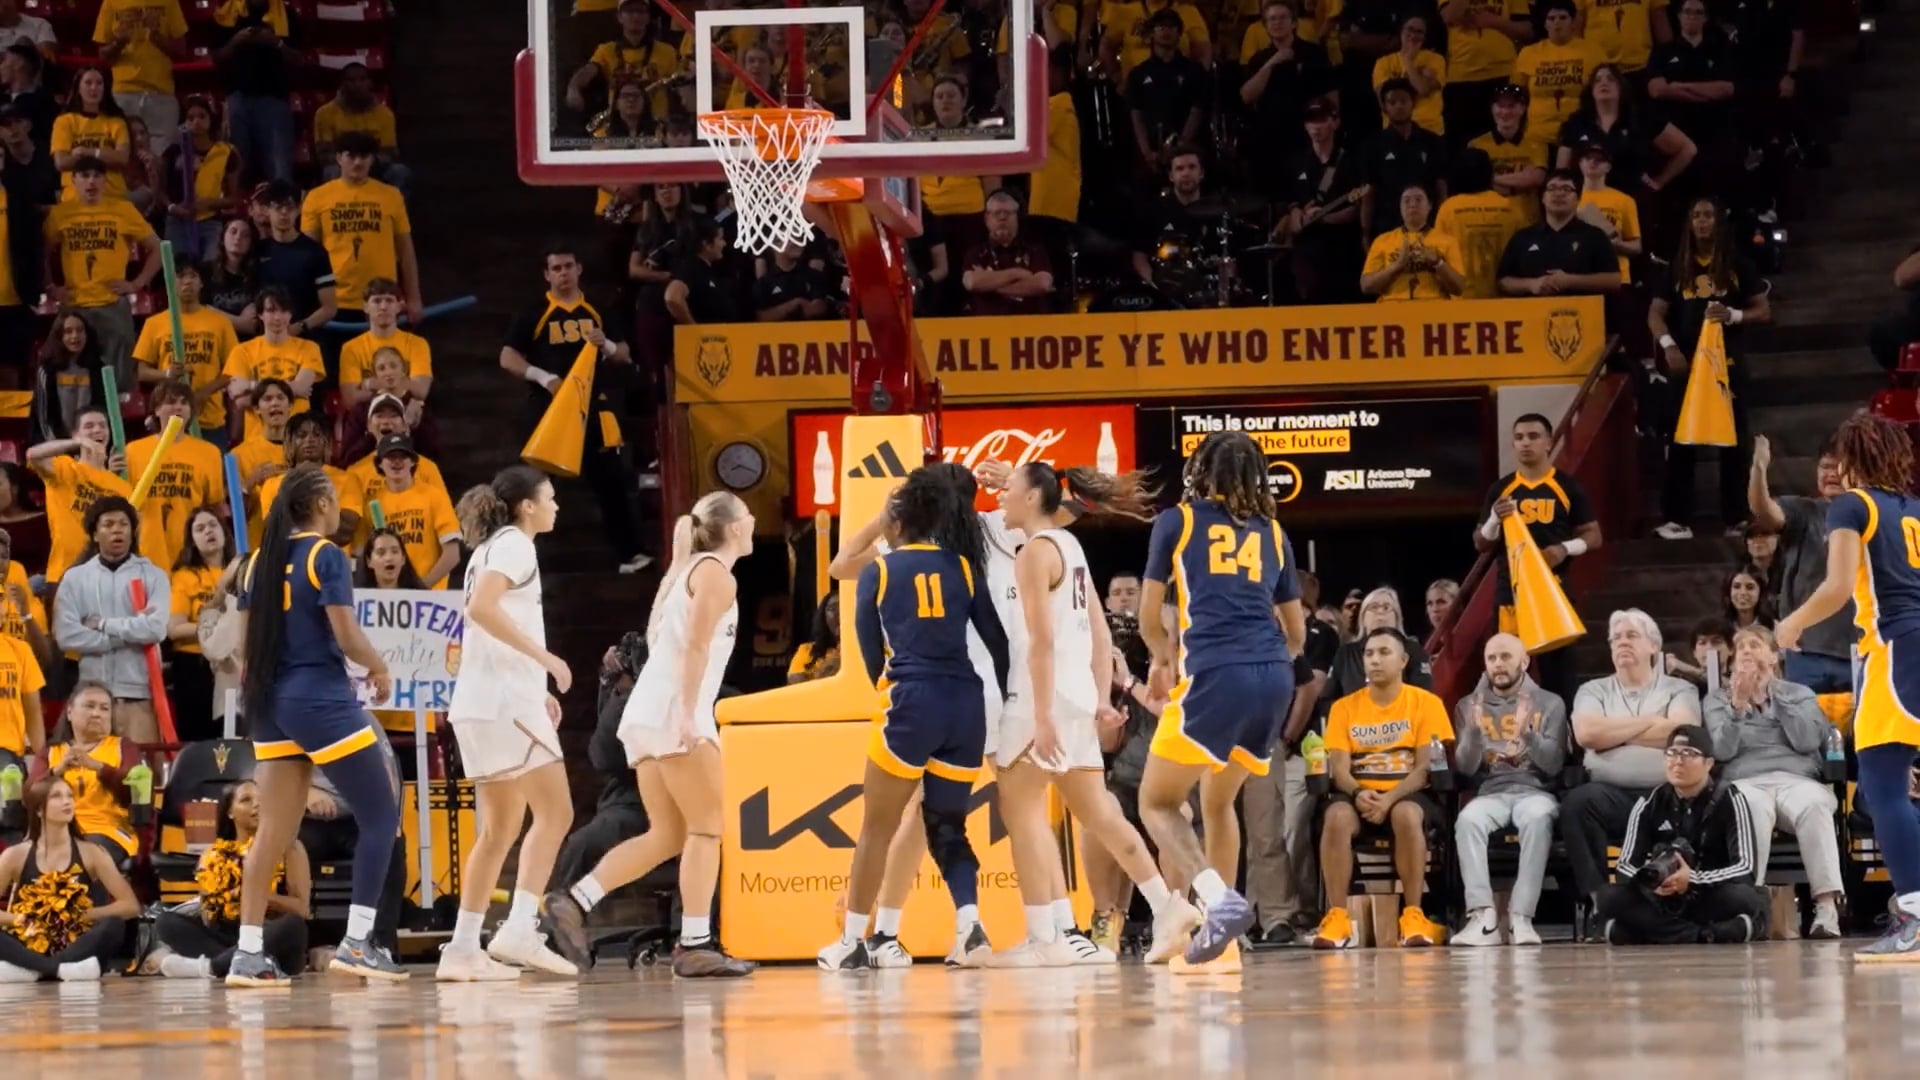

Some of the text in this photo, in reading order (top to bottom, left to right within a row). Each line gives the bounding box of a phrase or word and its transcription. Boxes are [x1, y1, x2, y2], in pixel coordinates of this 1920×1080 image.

[330, 208, 382, 220] SHOW IN
[332, 220, 381, 233] ARIZONA
[548, 318, 594, 345] ASU
[755, 320, 1525, 377] ABAND ALL HOPE YE WHO ENTER HERE
[1181, 409, 1379, 432] This is our moment to
[1258, 432, 1347, 449] the future
[180, 472, 194, 484] IN
[1323, 467, 1432, 491] ASU Arizona State
[1367, 478, 1416, 490] University
[147, 484, 192, 498] RIZONA
[411, 518, 425, 531] IN
[1208, 523, 1263, 584] 24
[914, 572, 946, 619] 11
[1072, 566, 1087, 611] 13
[1351, 719, 1410, 738] SUN DEVIL
[1480, 711, 1542, 742] AS
[739, 871, 850, 894] Moveme
